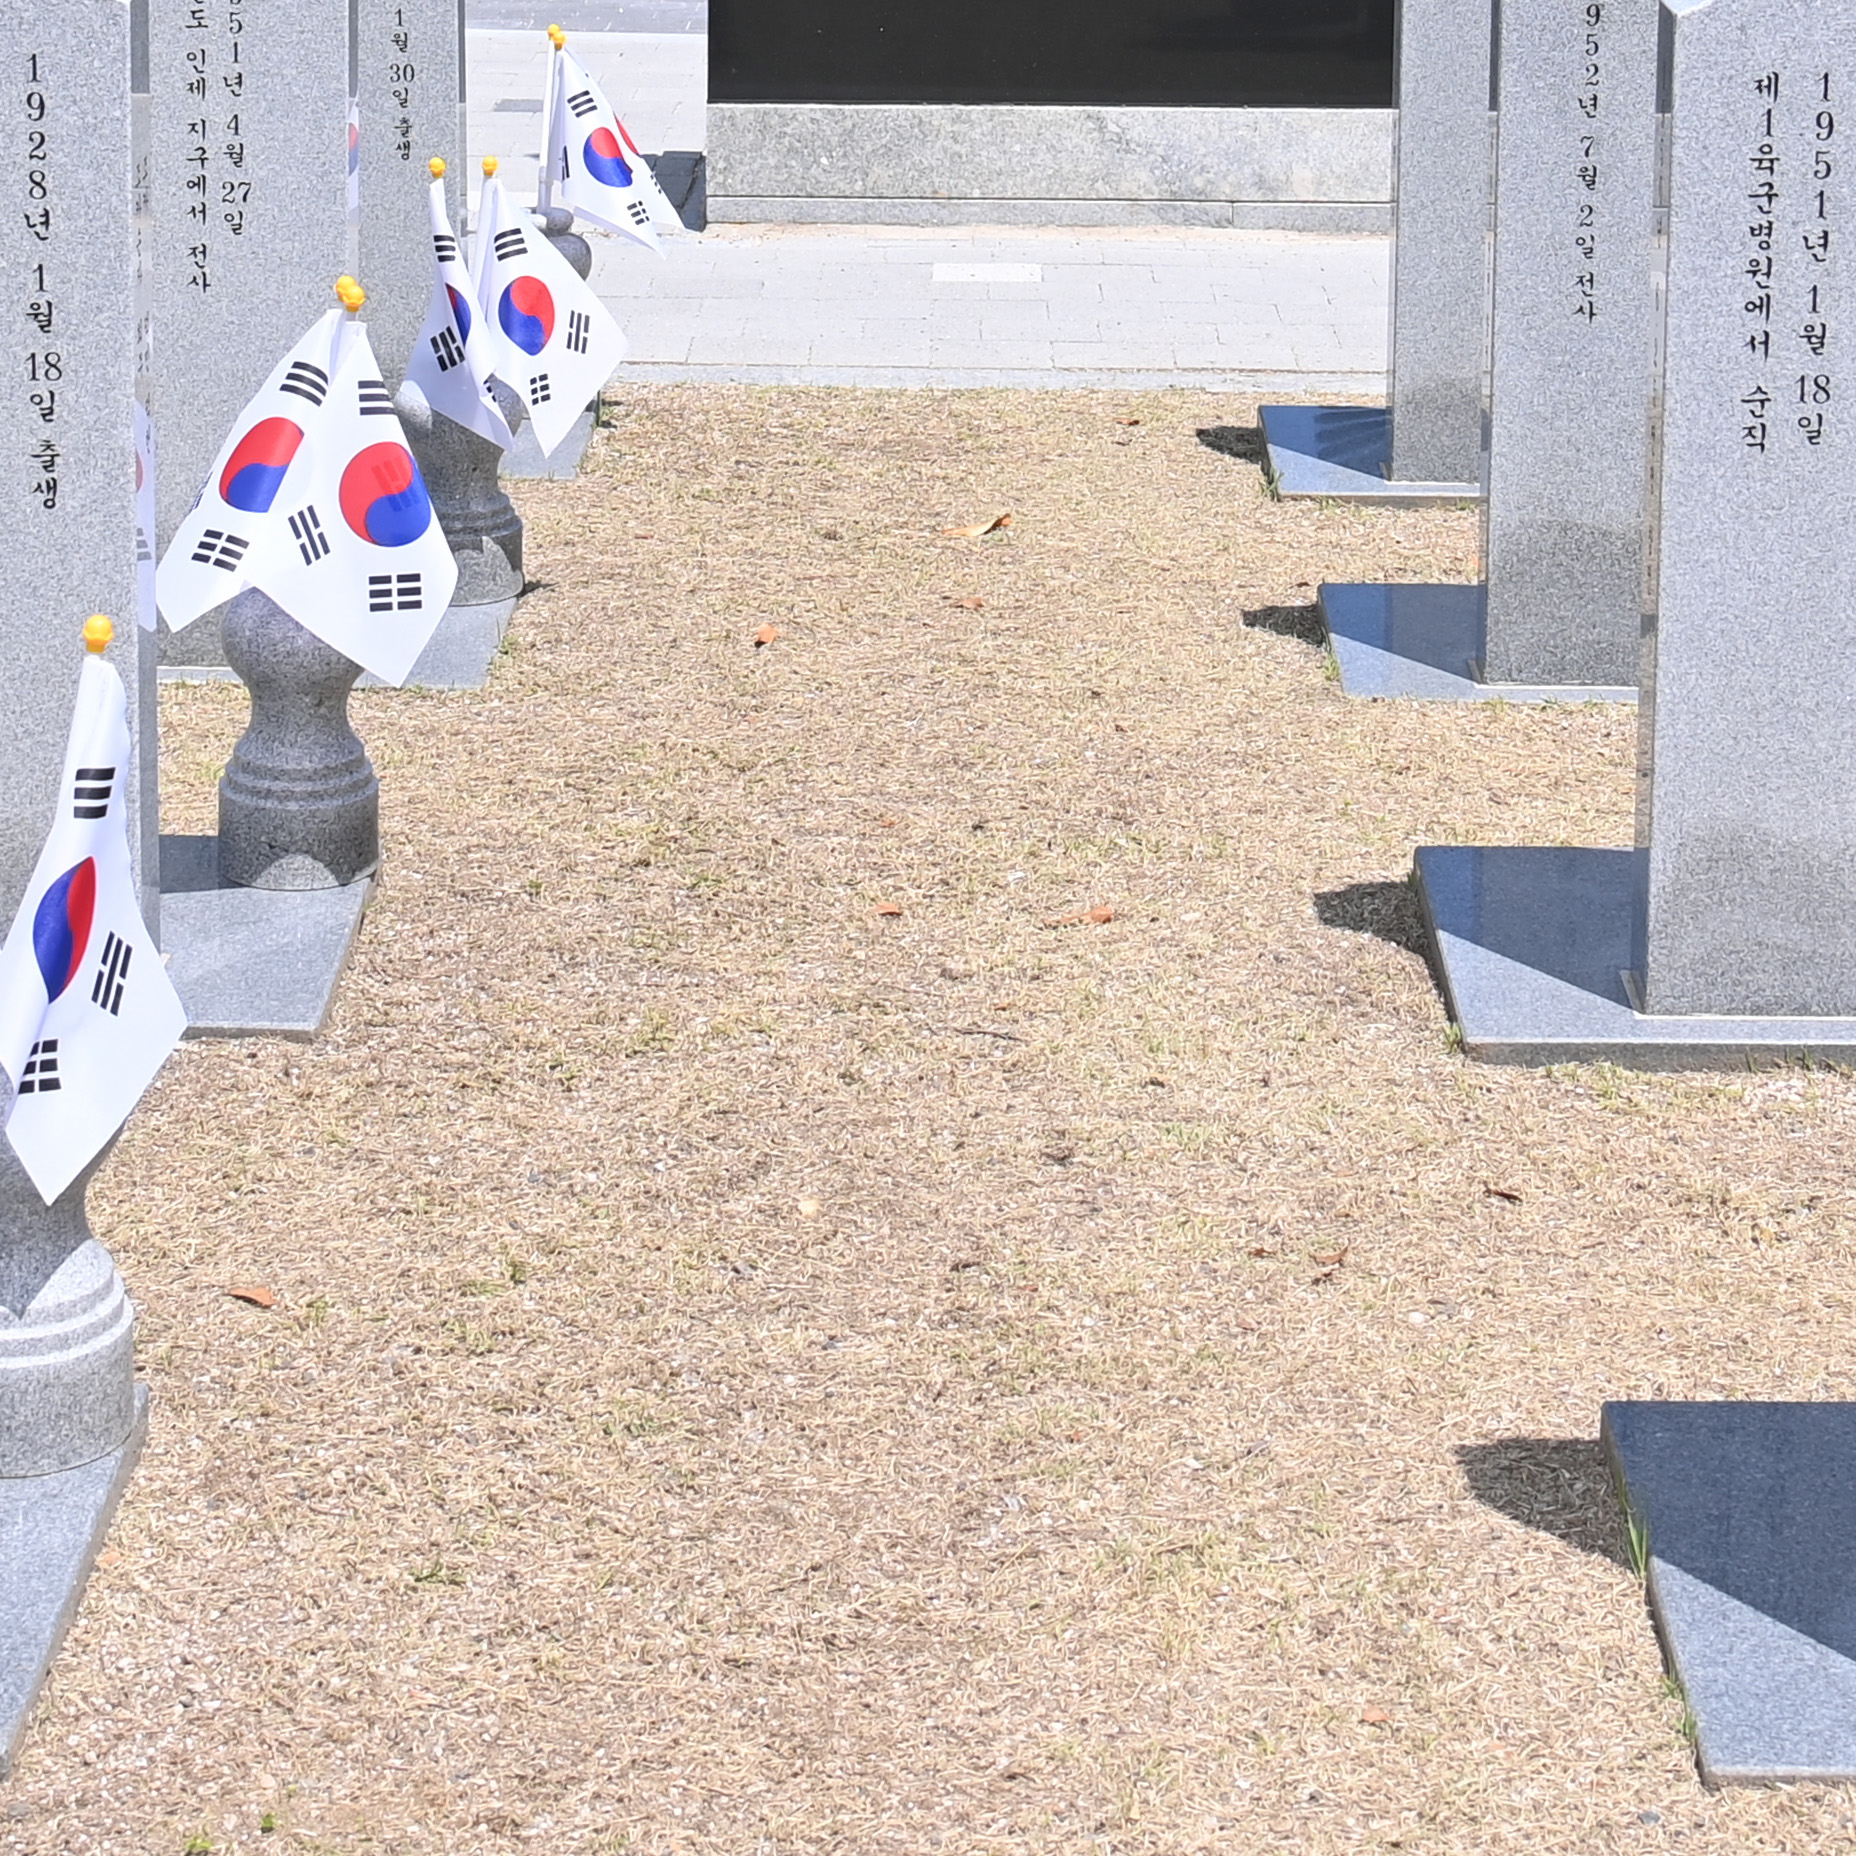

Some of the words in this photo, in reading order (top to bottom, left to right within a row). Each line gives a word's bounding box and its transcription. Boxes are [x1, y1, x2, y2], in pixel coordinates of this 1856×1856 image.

[392, 9, 408, 53] 1월
[187, 49, 206, 99] 인제
[390, 64, 415, 108] 30일
[24, 54, 50, 241] 1928년
[224, 114, 243, 168] 4월
[395, 118, 412, 160] 출생
[1578, 136, 1597, 190] 7월
[1803, 72, 1834, 262] 1951년
[187, 119, 208, 223] 지구에서
[222, 182, 251, 235] 27일
[1576, 205, 1594, 259] 2일
[1745, 72, 1780, 358] 제1육군병원에서
[190, 244, 210, 292] 전사
[1575, 272, 1596, 322] 전사
[27, 264, 52, 333] 1월
[1800, 285, 1826, 355] 1월
[27, 353, 62, 422] 18일
[1798, 375, 1830, 445] 18일
[1741, 386, 1771, 452] 순직
[32, 440, 60, 509] 출생
